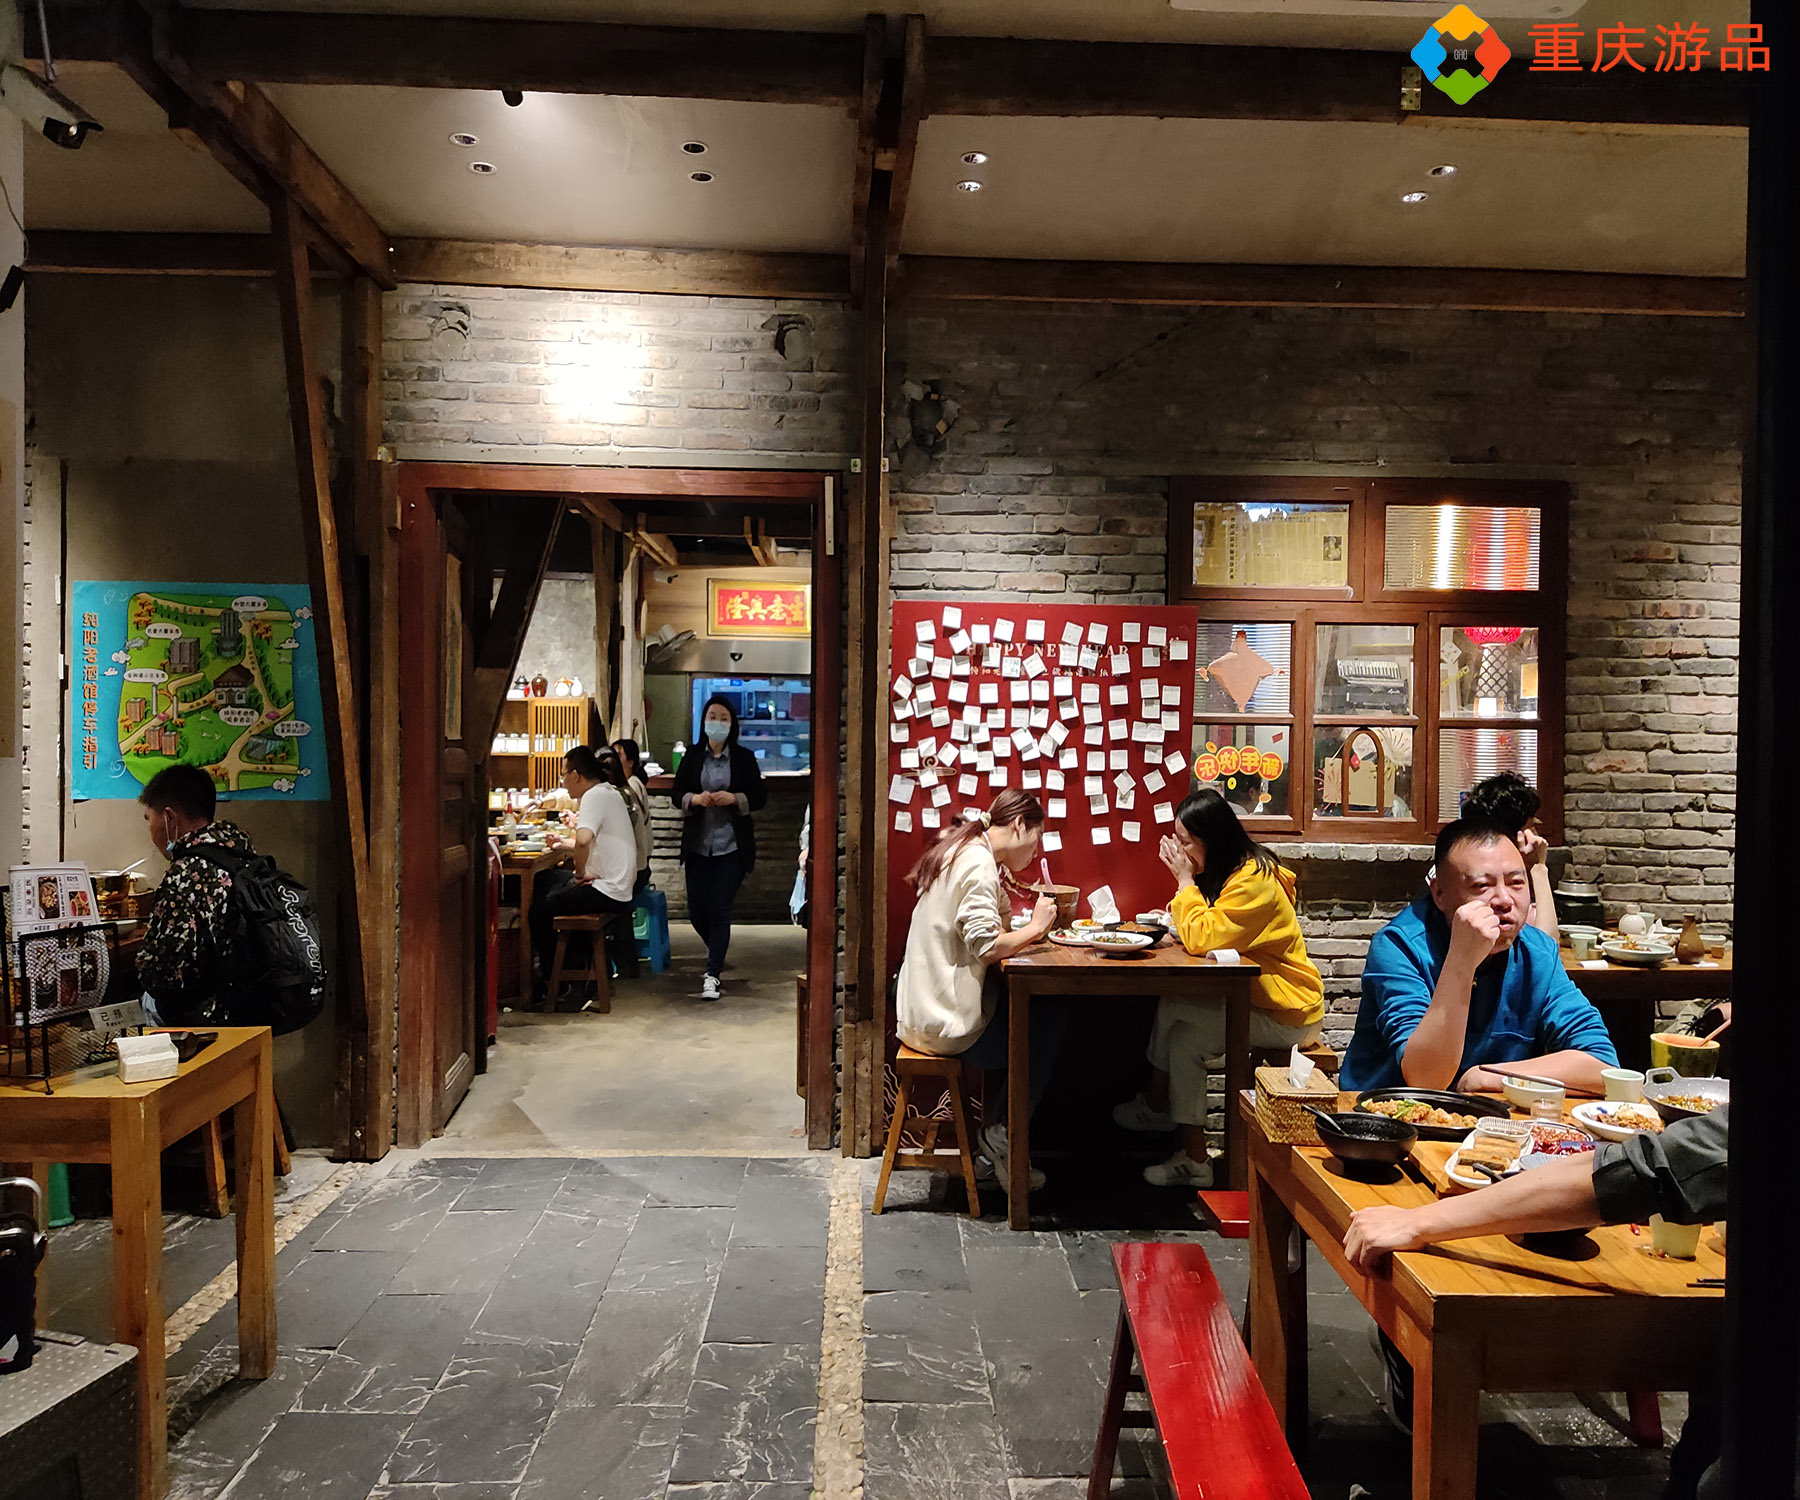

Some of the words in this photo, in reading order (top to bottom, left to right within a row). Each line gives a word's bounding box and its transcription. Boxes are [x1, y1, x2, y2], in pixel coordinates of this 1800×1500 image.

[82, 611, 99, 770] 纯阳老酒馆停车指引
[1081, 644, 1129, 659] EAR
